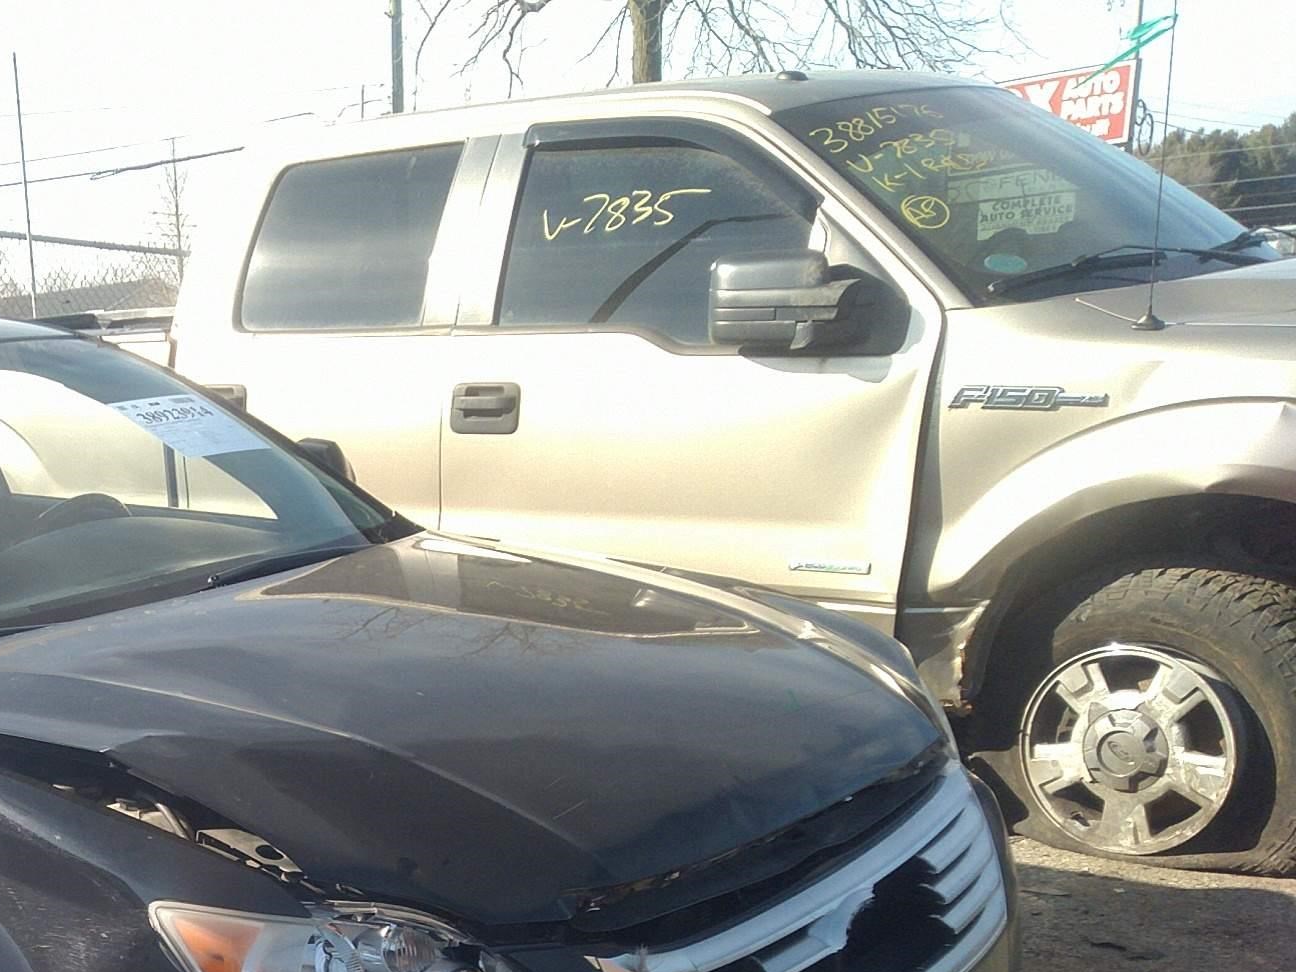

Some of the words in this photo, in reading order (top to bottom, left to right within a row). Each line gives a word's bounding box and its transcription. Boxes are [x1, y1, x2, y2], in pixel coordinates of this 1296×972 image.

[1062, 70, 1121, 100] AUTO
[1060, 92, 1125, 121] PARTS
[979, 211, 1015, 223] AUTO
[1020, 203, 1072, 219] SERVICE
